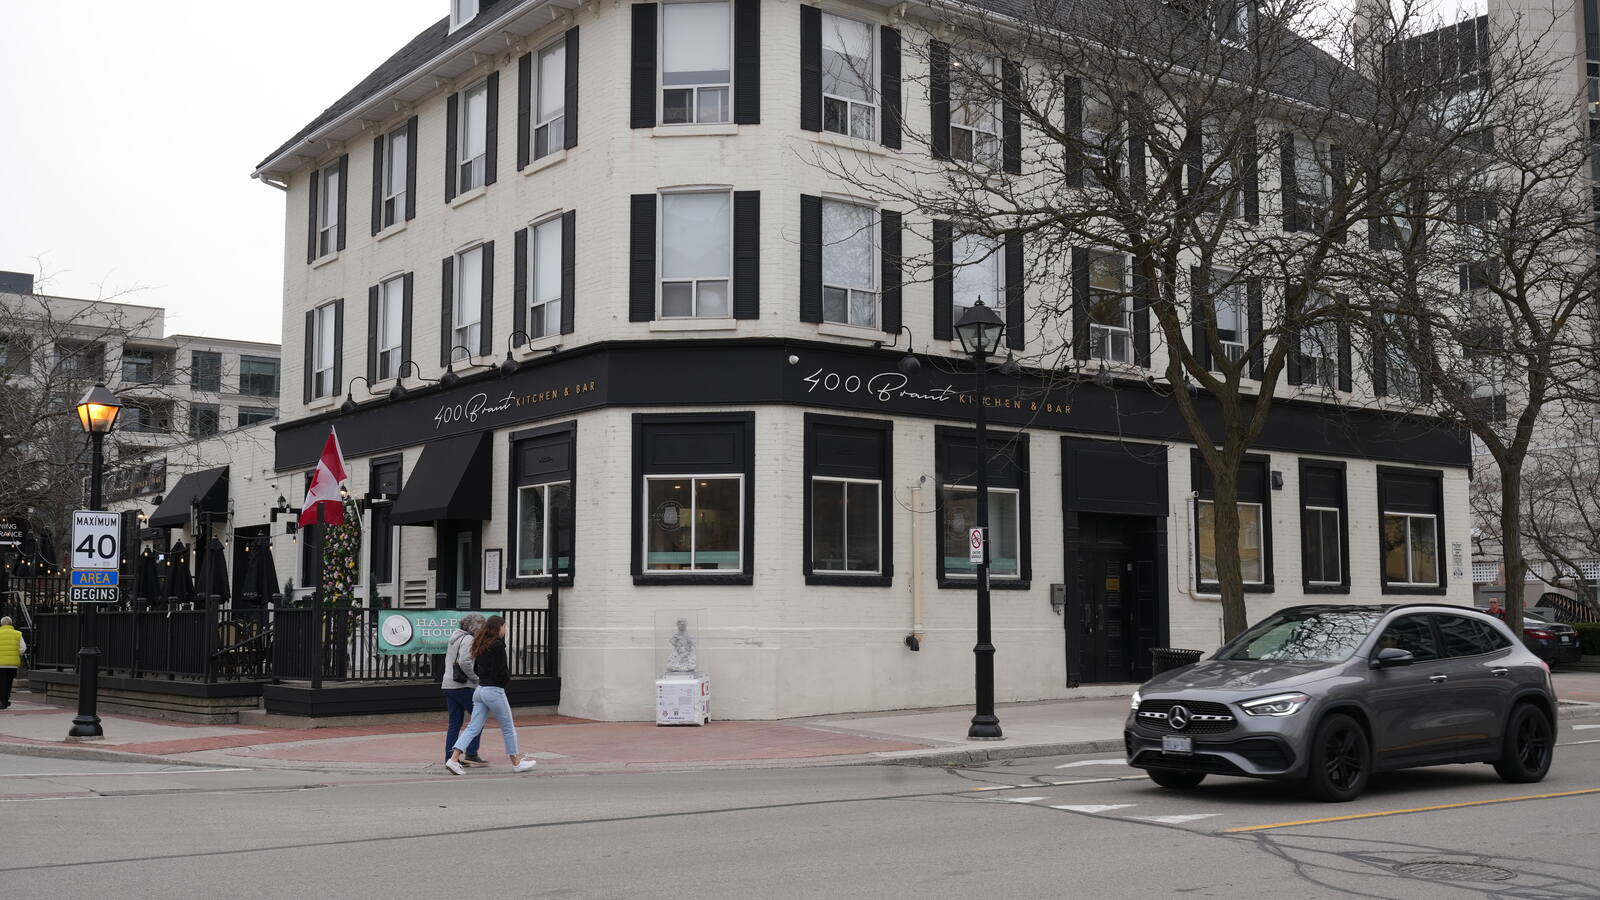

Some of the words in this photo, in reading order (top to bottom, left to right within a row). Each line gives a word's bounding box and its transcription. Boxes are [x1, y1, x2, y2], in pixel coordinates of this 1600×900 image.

[803, 368, 861, 393] 400
[867, 372, 957, 402] Brant
[959, 393, 1021, 409] KICHEN
[1030, 401, 1038, 411] &
[1046, 403, 1073, 414] BAR
[434, 405, 463, 431] 400
[464, 391, 516, 423] Brant
[516, 389, 558, 408] KITCHEN
[563, 387, 569, 396] &
[575, 381, 596, 395] BAR
[76, 517, 117, 526] MAXIMUM
[75, 534, 117, 560] 40
[79, 573, 111, 584] AREA
[74, 588, 116, 600] BEGINS
[416, 617, 462, 627] HAPP
[421, 628, 453, 637] HOU
